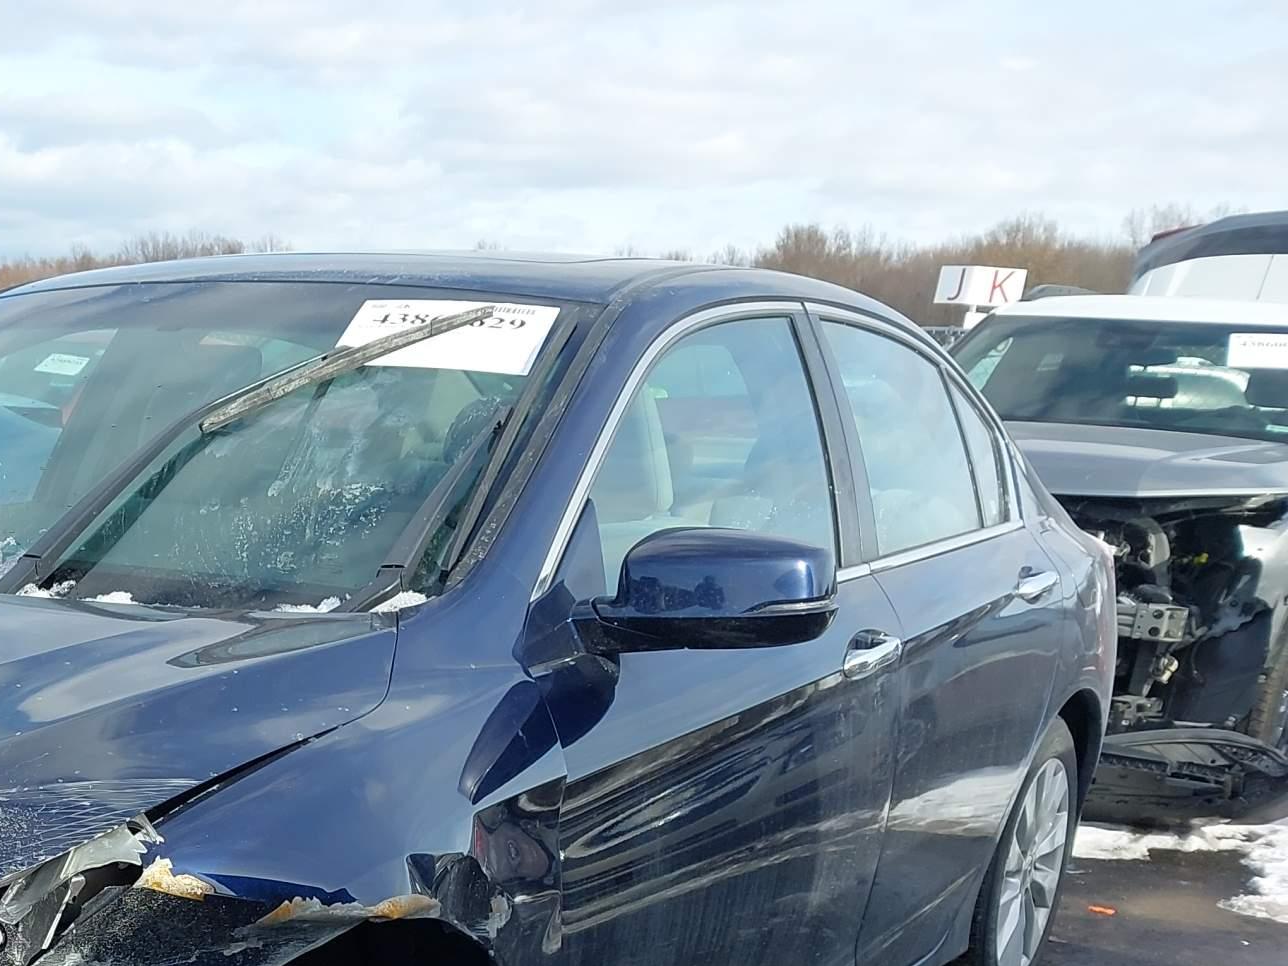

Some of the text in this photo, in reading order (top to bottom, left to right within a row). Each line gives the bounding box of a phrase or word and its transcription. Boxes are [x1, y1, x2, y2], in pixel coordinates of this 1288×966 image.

[946, 267, 967, 301] J
[988, 269, 1017, 304] K
[372, 312, 527, 330] 438629
